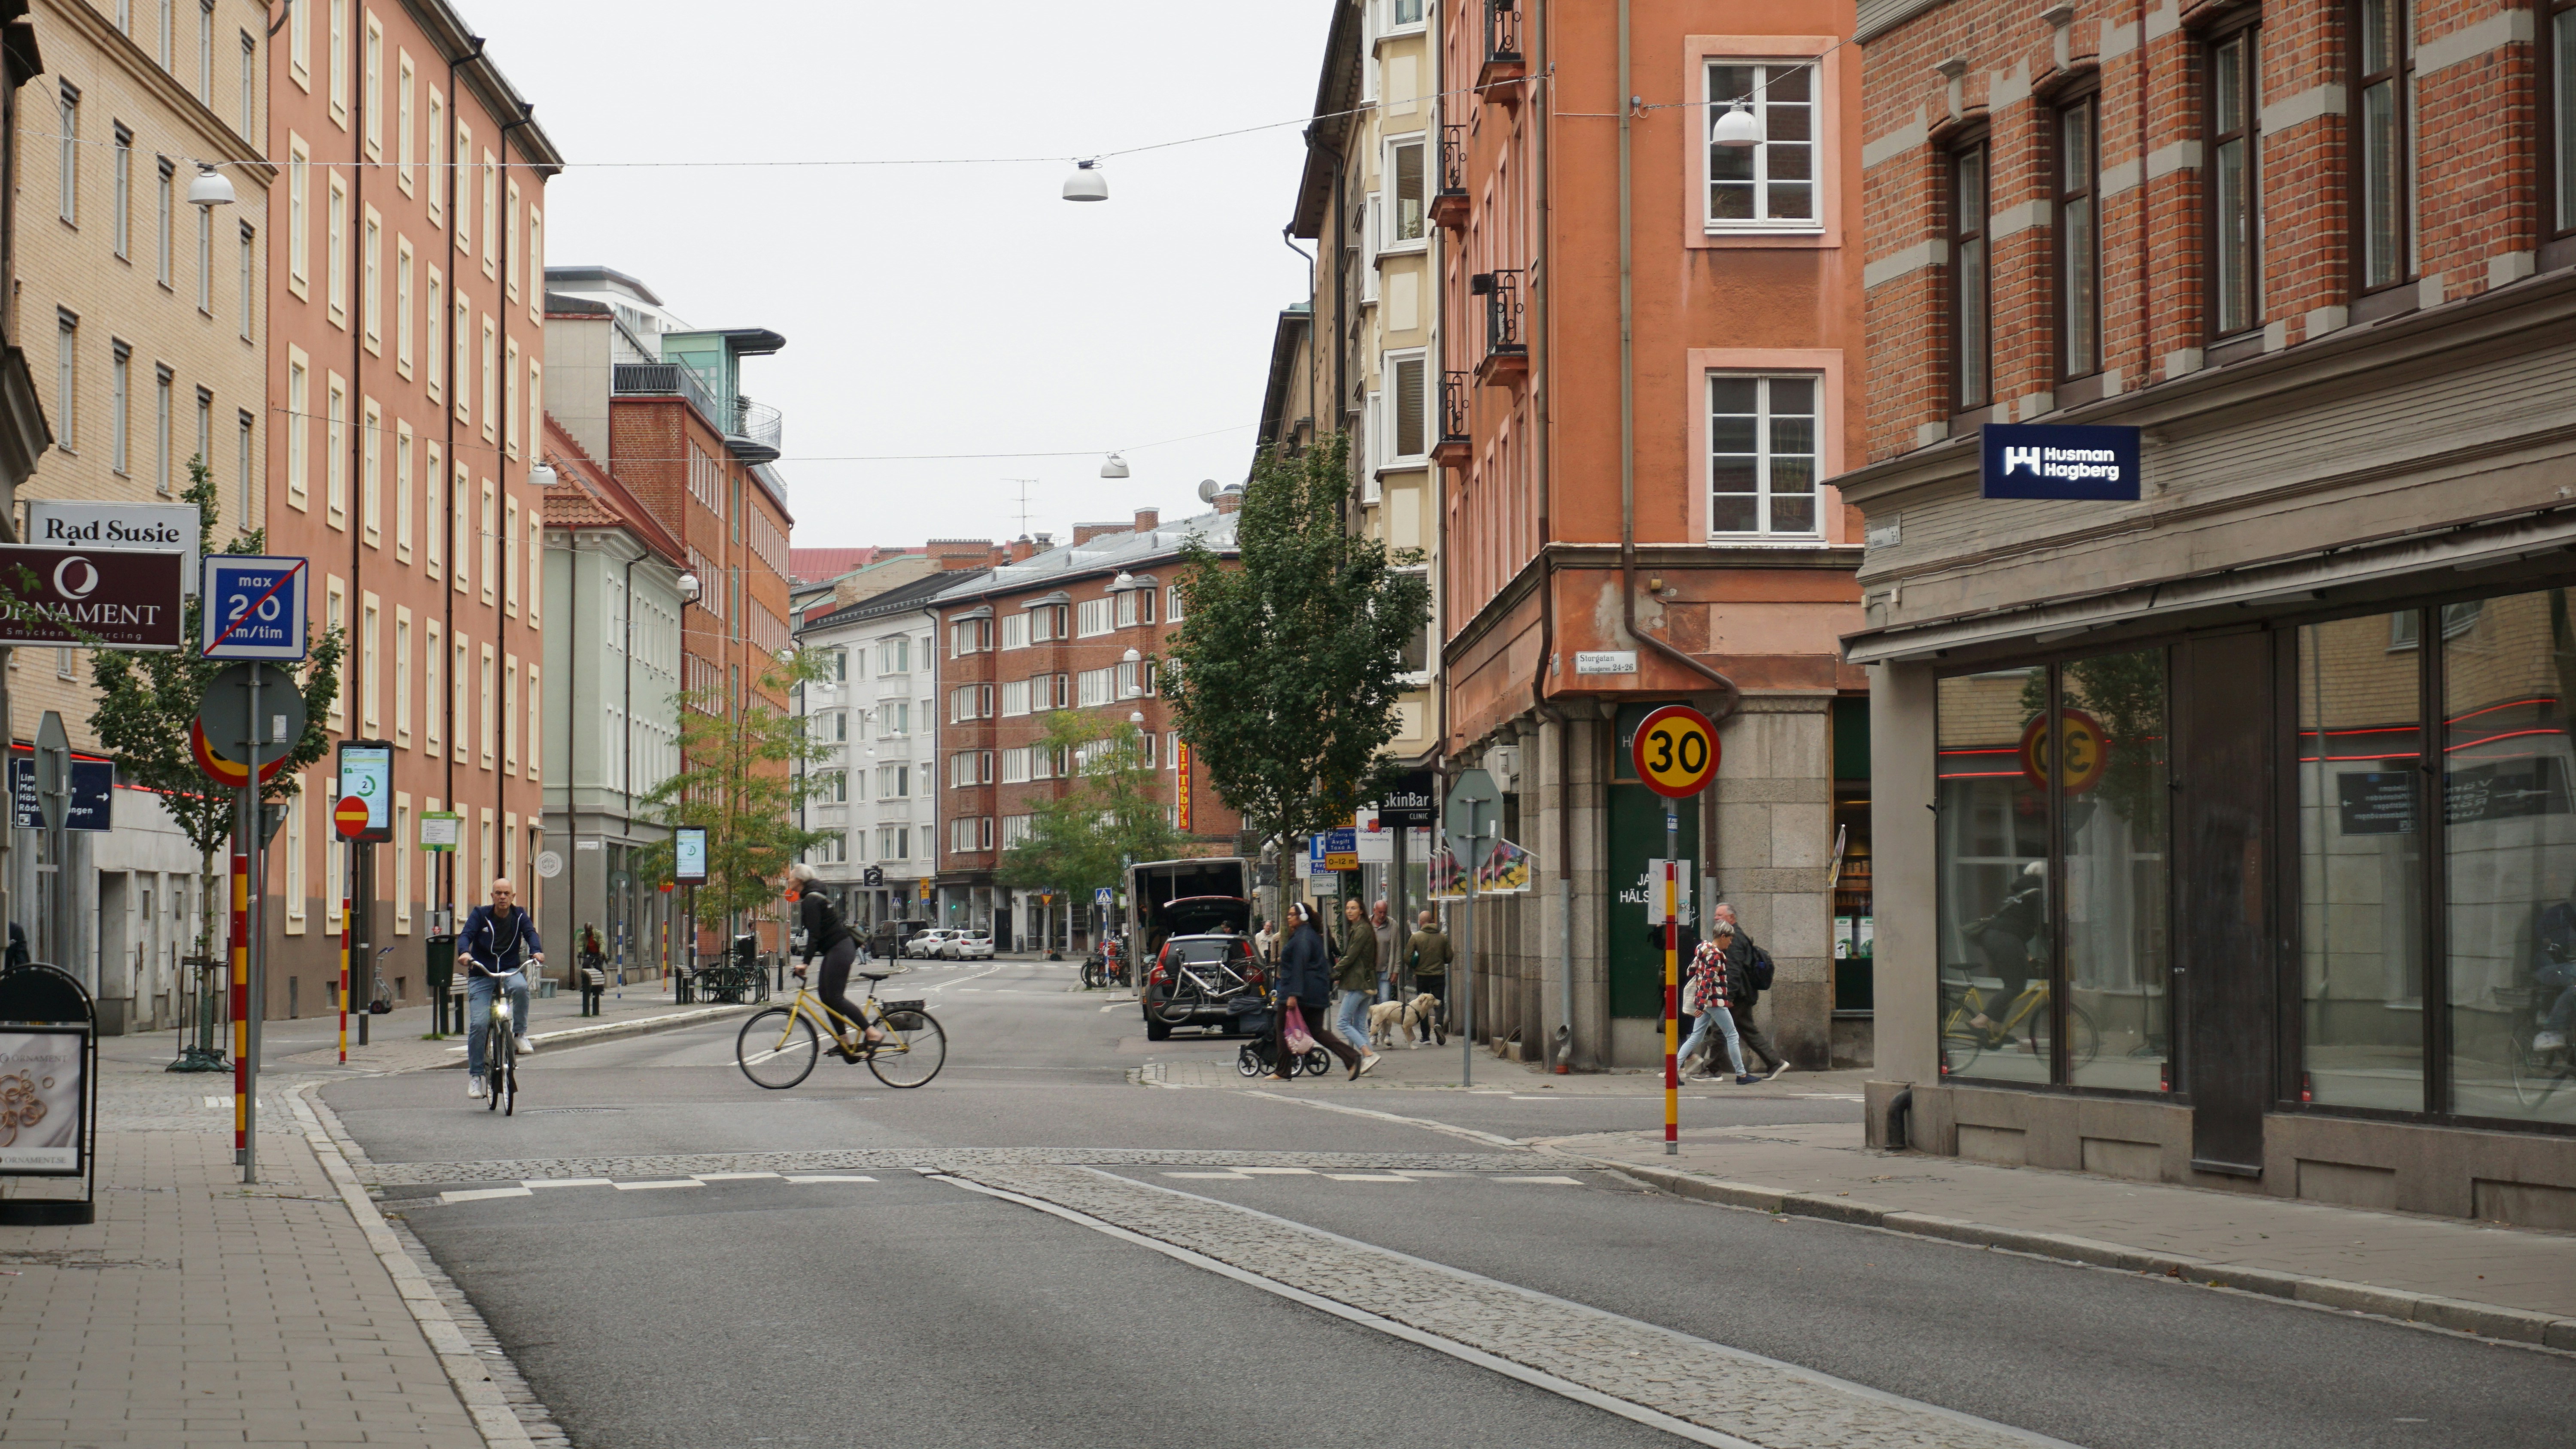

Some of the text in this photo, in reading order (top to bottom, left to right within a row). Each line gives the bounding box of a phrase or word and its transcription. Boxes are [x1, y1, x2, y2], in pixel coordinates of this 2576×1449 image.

[2045, 447, 2114, 461] Husman
[2045, 463, 2119, 481] Hagberg
[45, 518, 180, 543] Rad Susie
[239, 577, 272, 587] max
[228, 594, 280, 621] 20
[7, 628, 64, 637] Smycken
[83, 630, 142, 641] Percing
[225, 625, 283, 638] km/tim
[1580, 654, 1615, 664] Storgatan
[1649, 730, 1707, 773] 30
[1179, 742, 1189, 827] Sir Toby's
[1384, 791, 1429, 807] SkinBar
